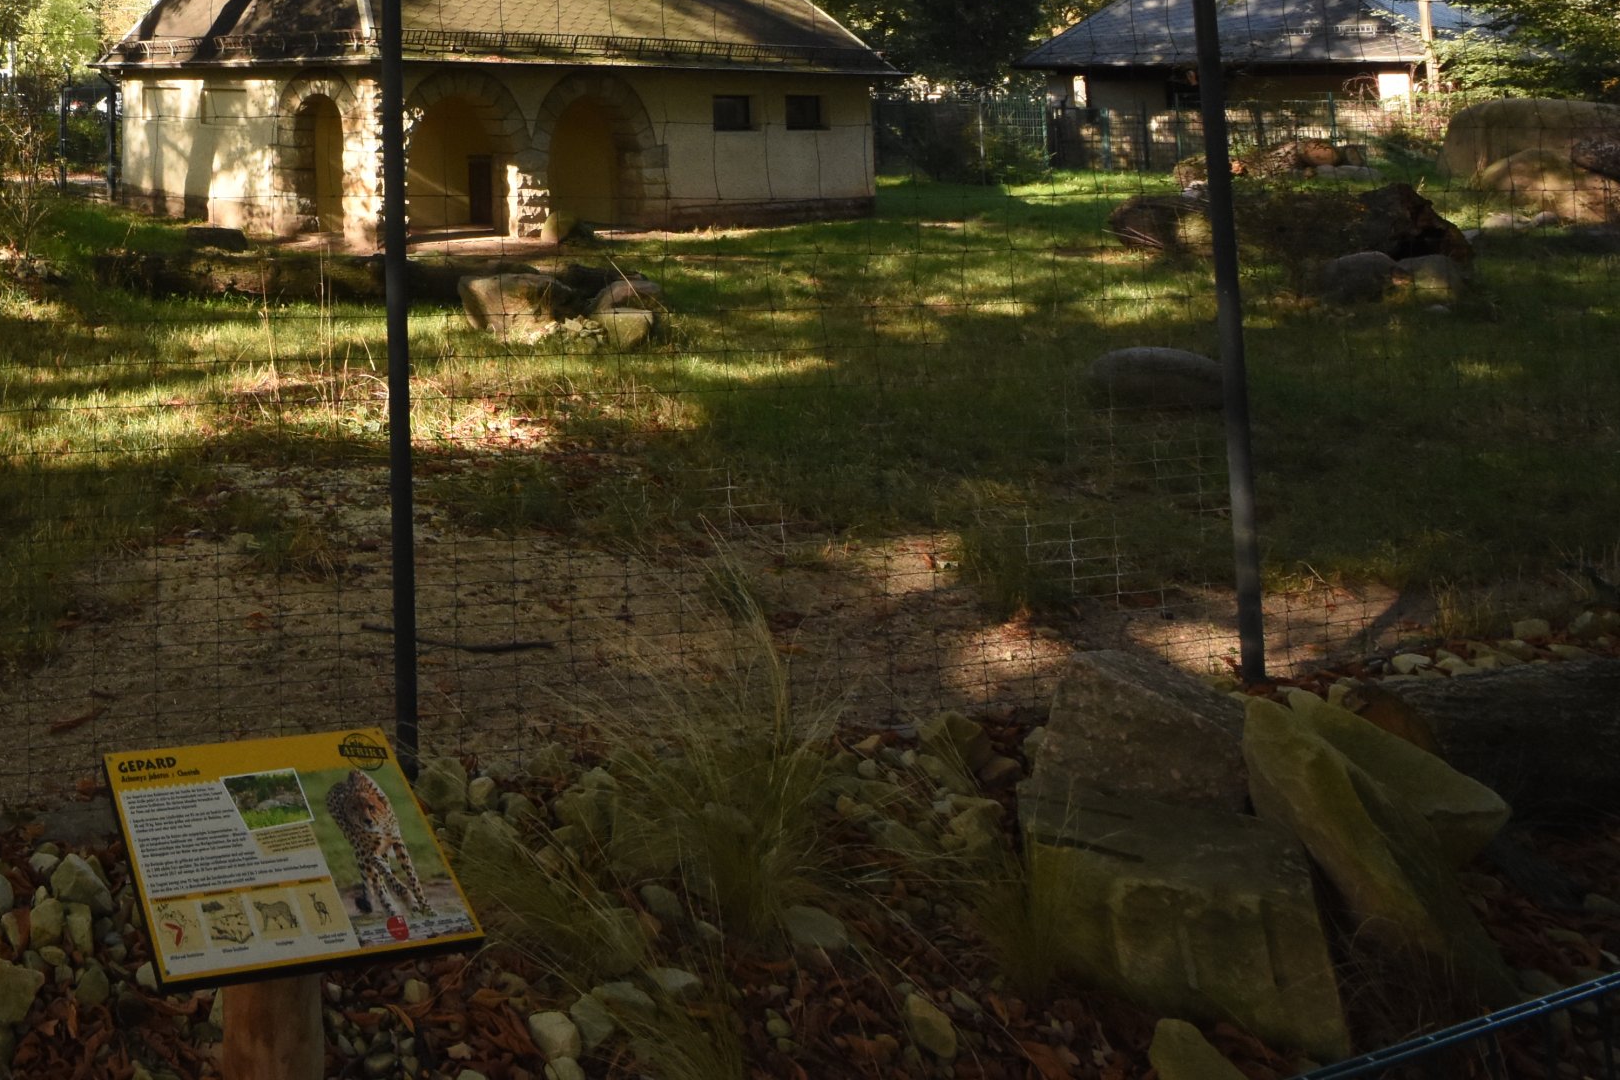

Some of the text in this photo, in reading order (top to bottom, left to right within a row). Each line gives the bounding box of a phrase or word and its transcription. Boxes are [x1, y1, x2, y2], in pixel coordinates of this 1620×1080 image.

[342, 745, 386, 758] AFRIKA
[118, 756, 177, 773] GEPARD
[177, 768, 200, 777] Cheetah
